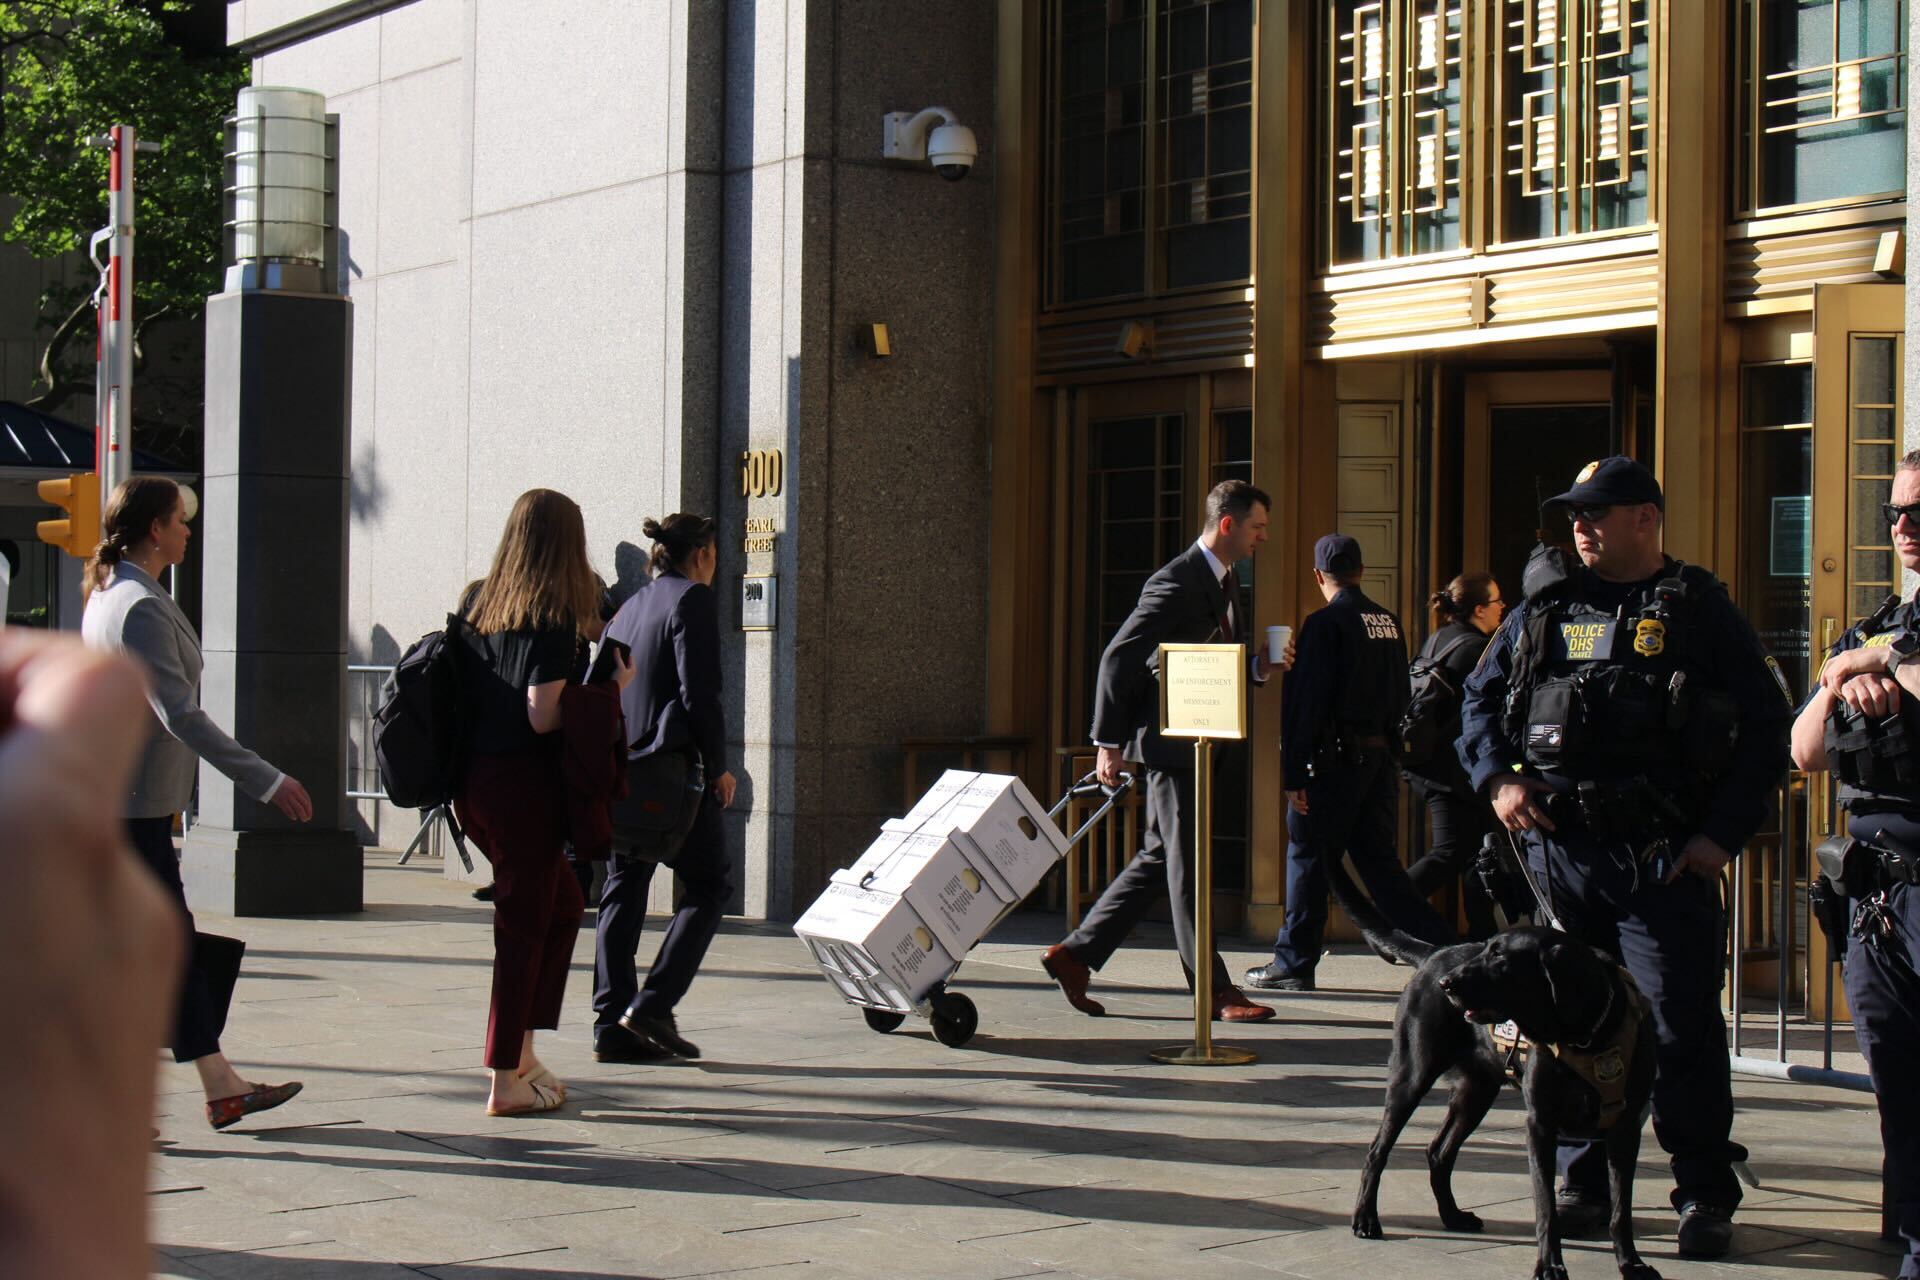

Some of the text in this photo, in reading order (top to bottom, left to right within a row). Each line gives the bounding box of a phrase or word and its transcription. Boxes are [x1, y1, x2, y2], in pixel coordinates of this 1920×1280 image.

[744, 518, 775, 533] EARL
[743, 538, 776, 554] TREET
[1360, 613, 1397, 627] POLICE
[1367, 626, 1398, 639] USMS
[1563, 624, 1606, 637] POLICE
[1569, 637, 1595, 651] DHS
[1183, 656, 1220, 664] ATTORNEYS
[1568, 651, 1593, 659] CHAVEZ
[1172, 677, 1231, 686] LAW ENFORCEMENT
[1183, 698, 1221, 706] MESSENGERS
[1193, 718, 1210, 726] ONLY
